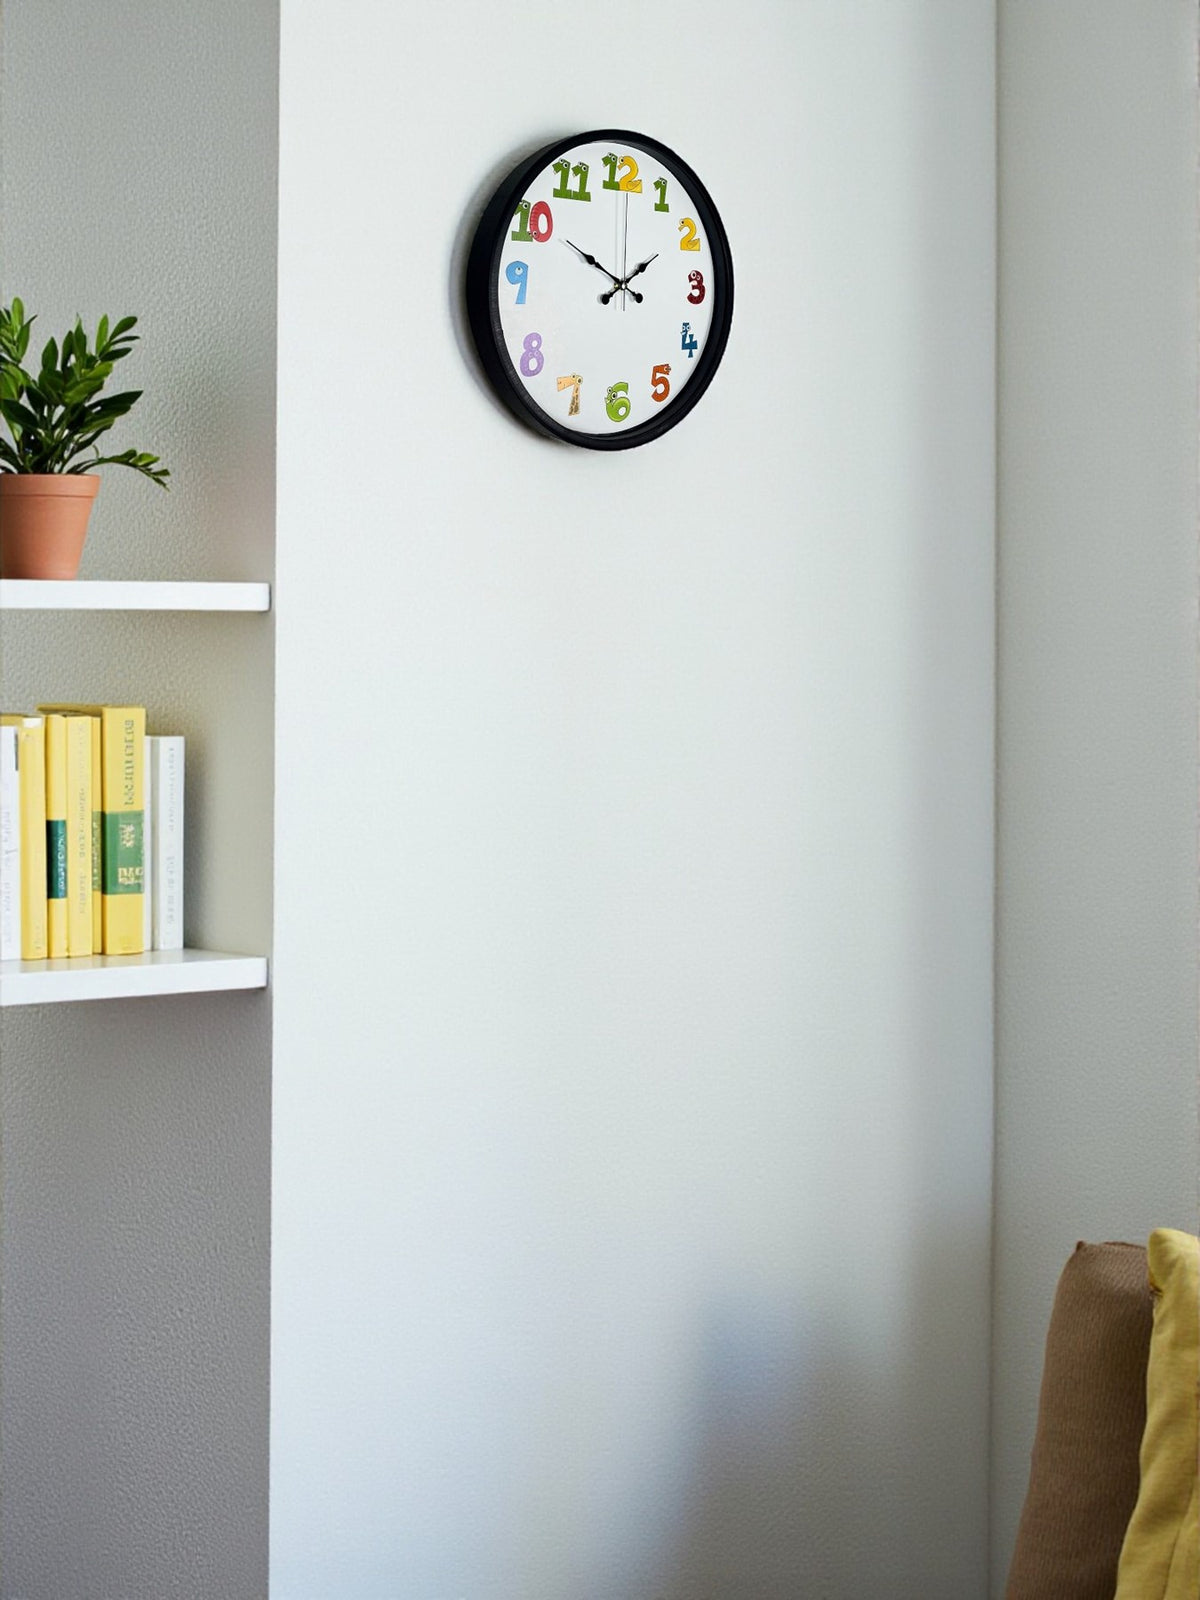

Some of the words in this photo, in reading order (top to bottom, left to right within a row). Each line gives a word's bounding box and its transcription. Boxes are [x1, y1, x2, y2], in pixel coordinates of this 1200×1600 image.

[553, 158, 591, 202] 11
[602, 152, 643, 193] 12
[653, 177, 669, 212] 1
[511, 199, 553, 242] 10
[678, 217, 700, 251] 2
[505, 260, 529, 304] 9
[687, 270, 705, 305] 3
[520, 332, 544, 377] 8
[680, 322, 698, 358] 4
[557, 373, 583, 416] 7
[604, 381, 631, 423] 6
[651, 363, 671, 402] 5
